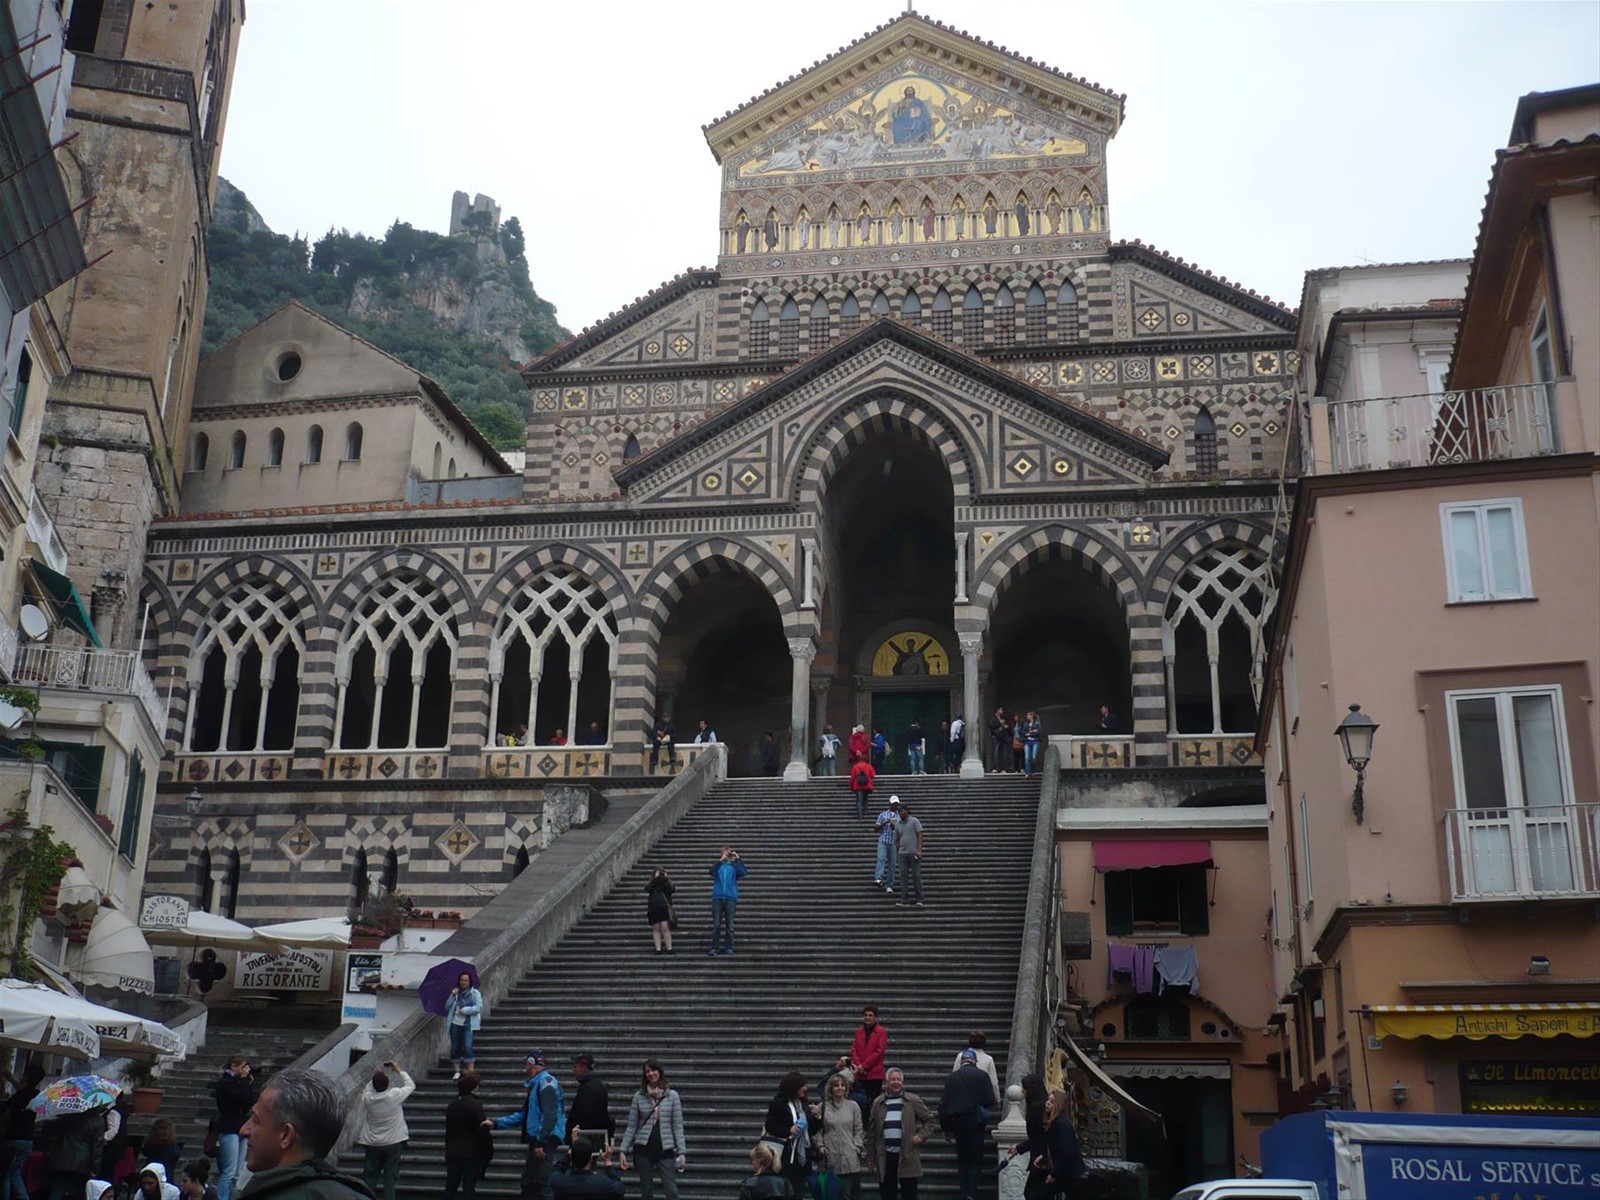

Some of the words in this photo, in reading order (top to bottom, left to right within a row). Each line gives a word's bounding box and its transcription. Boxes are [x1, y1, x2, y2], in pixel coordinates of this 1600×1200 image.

[146, 896, 185, 916] RISTORANTE
[143, 914, 187, 924] CHIOSTRO
[290, 951, 323, 974] APOSTOLI
[242, 973, 320, 988] RISTORANTE
[88, 1024, 128, 1039] REA
[1455, 1014, 1508, 1034] Antichi
[1516, 1013, 1569, 1034] Sapori
[1514, 1063, 1600, 1081] Limoncel
[61, 1097, 88, 1107] HONG
[1390, 1157, 1471, 1182] ROSAL
[1481, 1160, 1584, 1186] SERVICE
